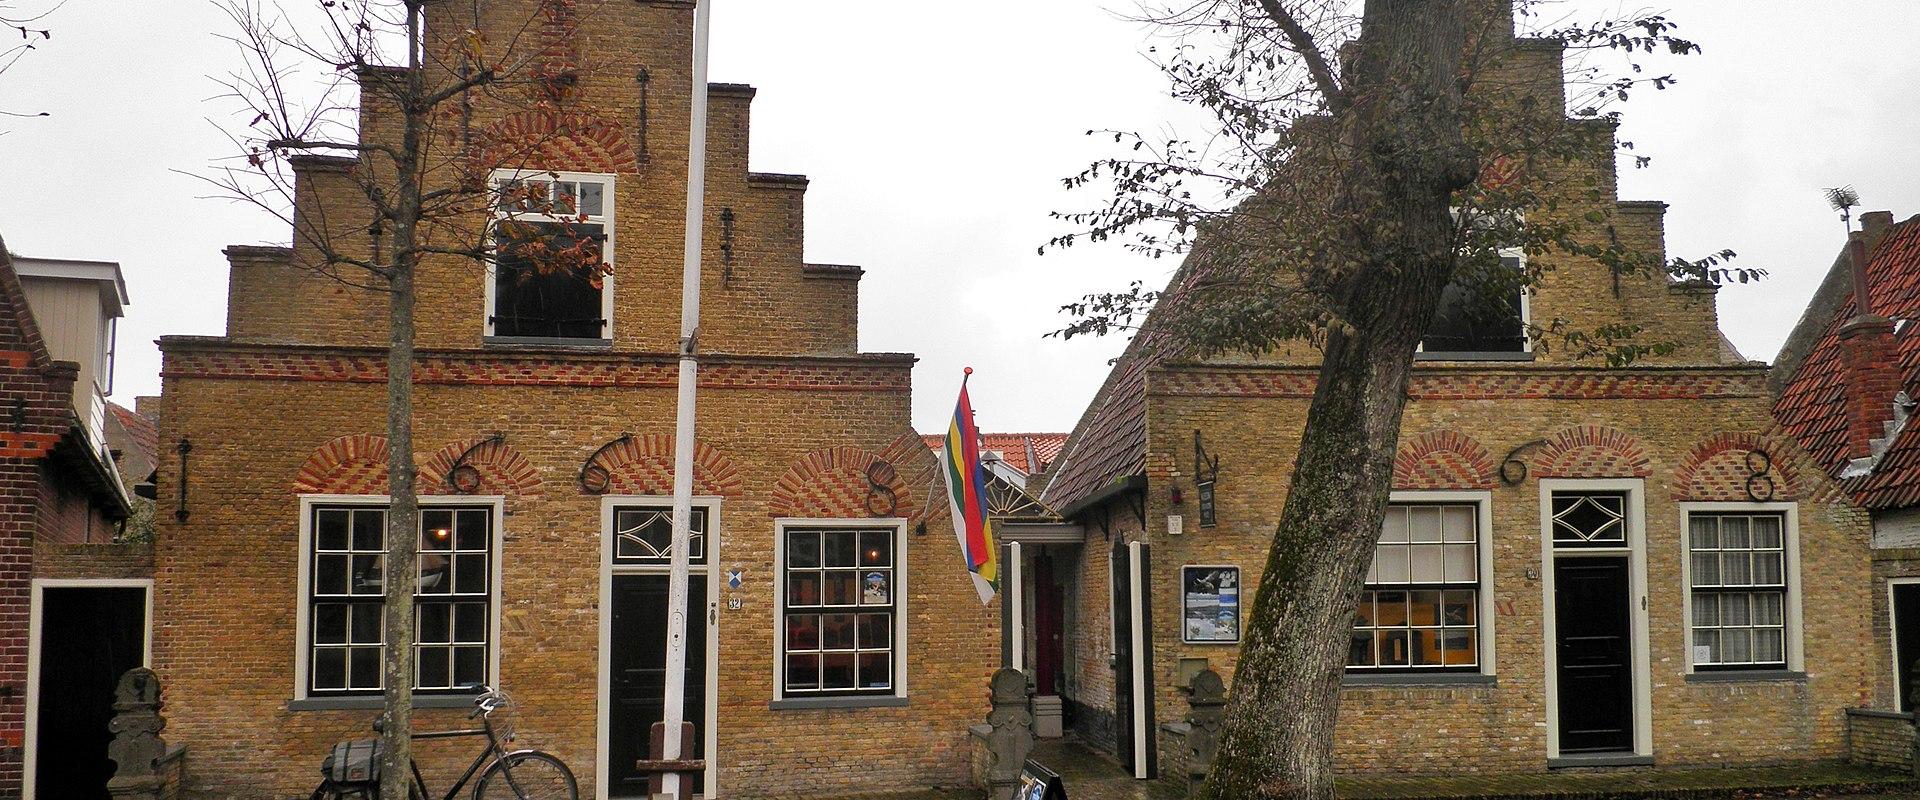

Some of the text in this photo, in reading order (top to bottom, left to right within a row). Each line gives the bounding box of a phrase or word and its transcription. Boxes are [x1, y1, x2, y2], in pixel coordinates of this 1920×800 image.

[1500, 438, 1774, 502] 6 8
[729, 598, 741, 609] 32
